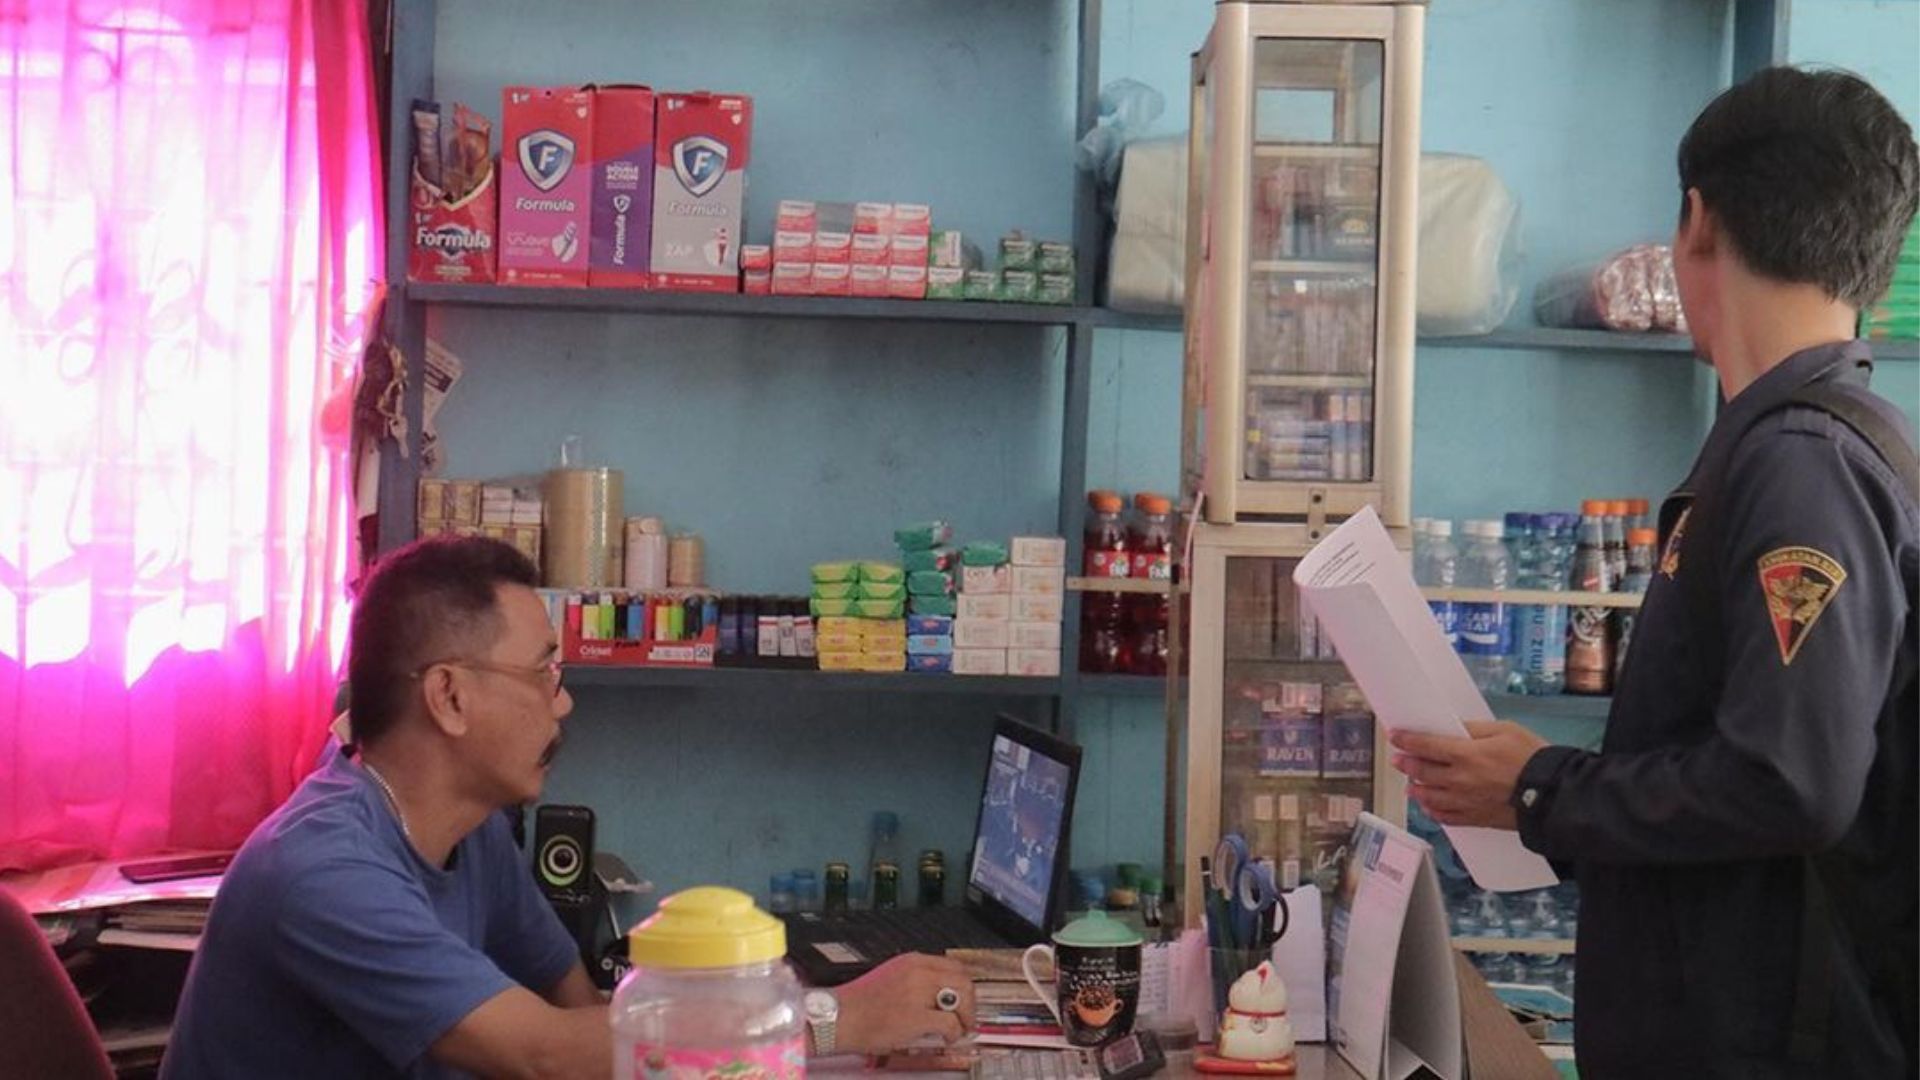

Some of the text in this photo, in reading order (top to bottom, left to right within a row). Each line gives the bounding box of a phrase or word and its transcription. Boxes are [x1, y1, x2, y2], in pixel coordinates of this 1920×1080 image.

[538, 145, 558, 171] F
[693, 151, 713, 176] F
[515, 196, 576, 213] Formula
[666, 202, 727, 217] Formula
[417, 226, 491, 249] Formula
[613, 213, 627, 265] Formula
[1266, 747, 1314, 761] RAVEN
